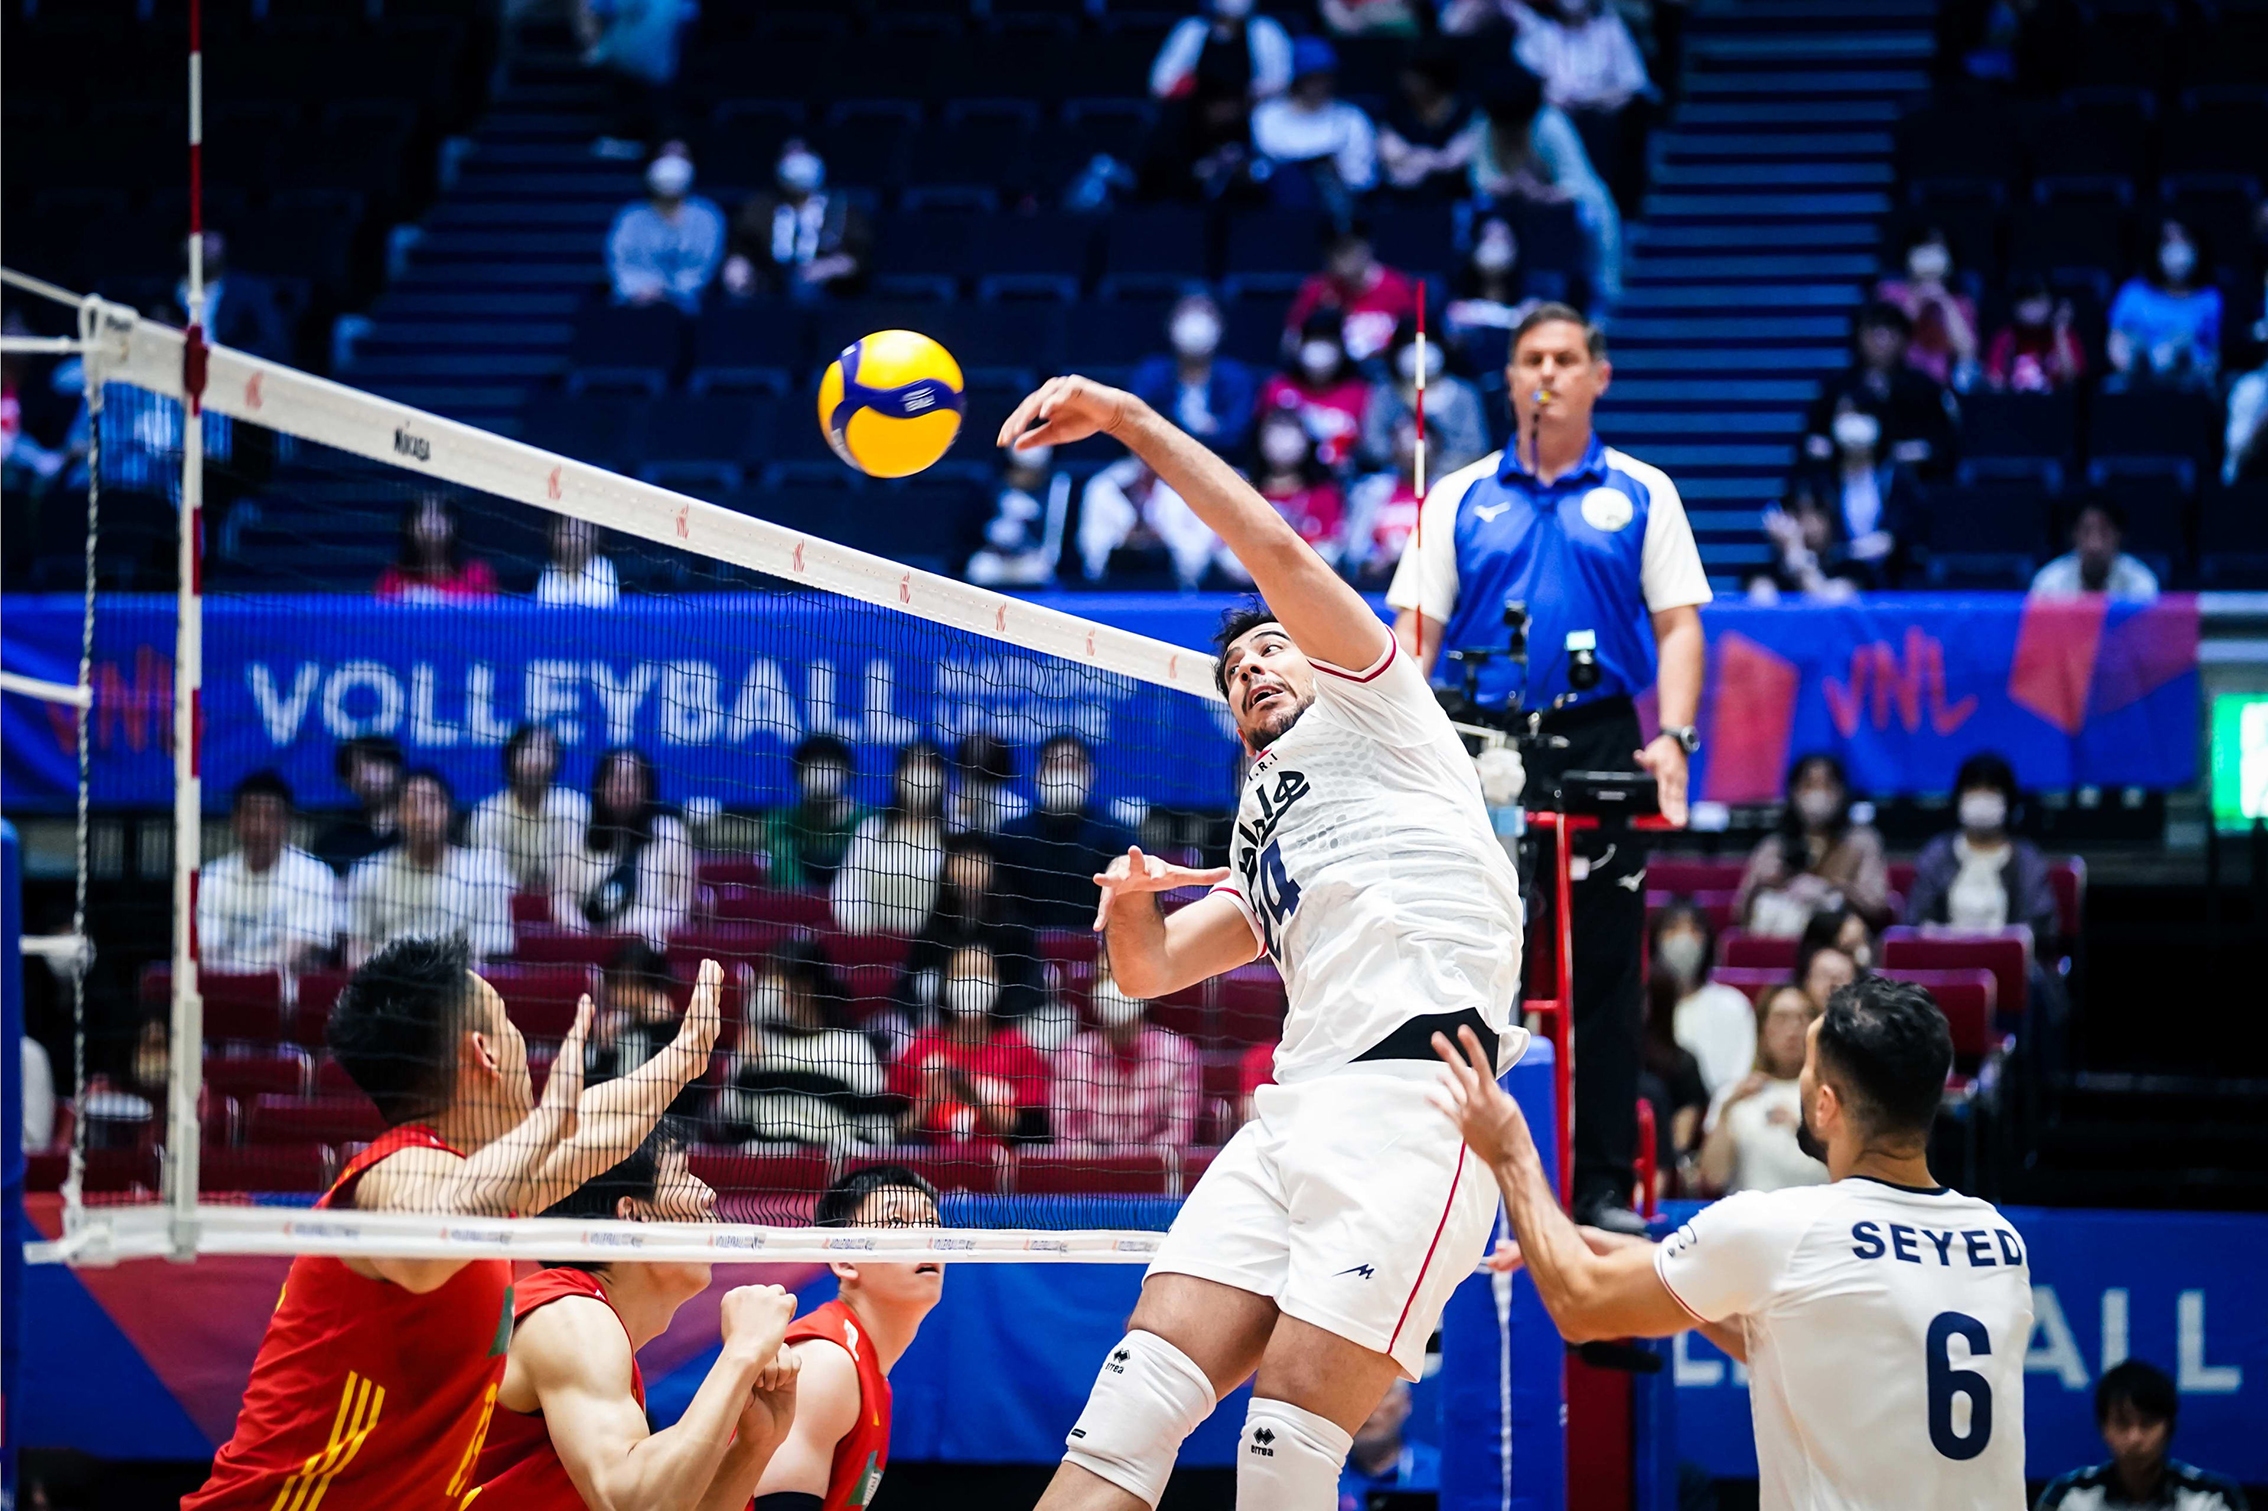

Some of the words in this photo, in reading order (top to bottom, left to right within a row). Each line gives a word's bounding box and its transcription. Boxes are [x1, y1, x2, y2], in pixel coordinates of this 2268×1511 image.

[247, 657, 921, 747] VOLLEYBALL
[1822, 624, 1980, 740] VNL
[1850, 1220, 2024, 1269] SEYED
[1926, 1310, 1993, 1461] 6
